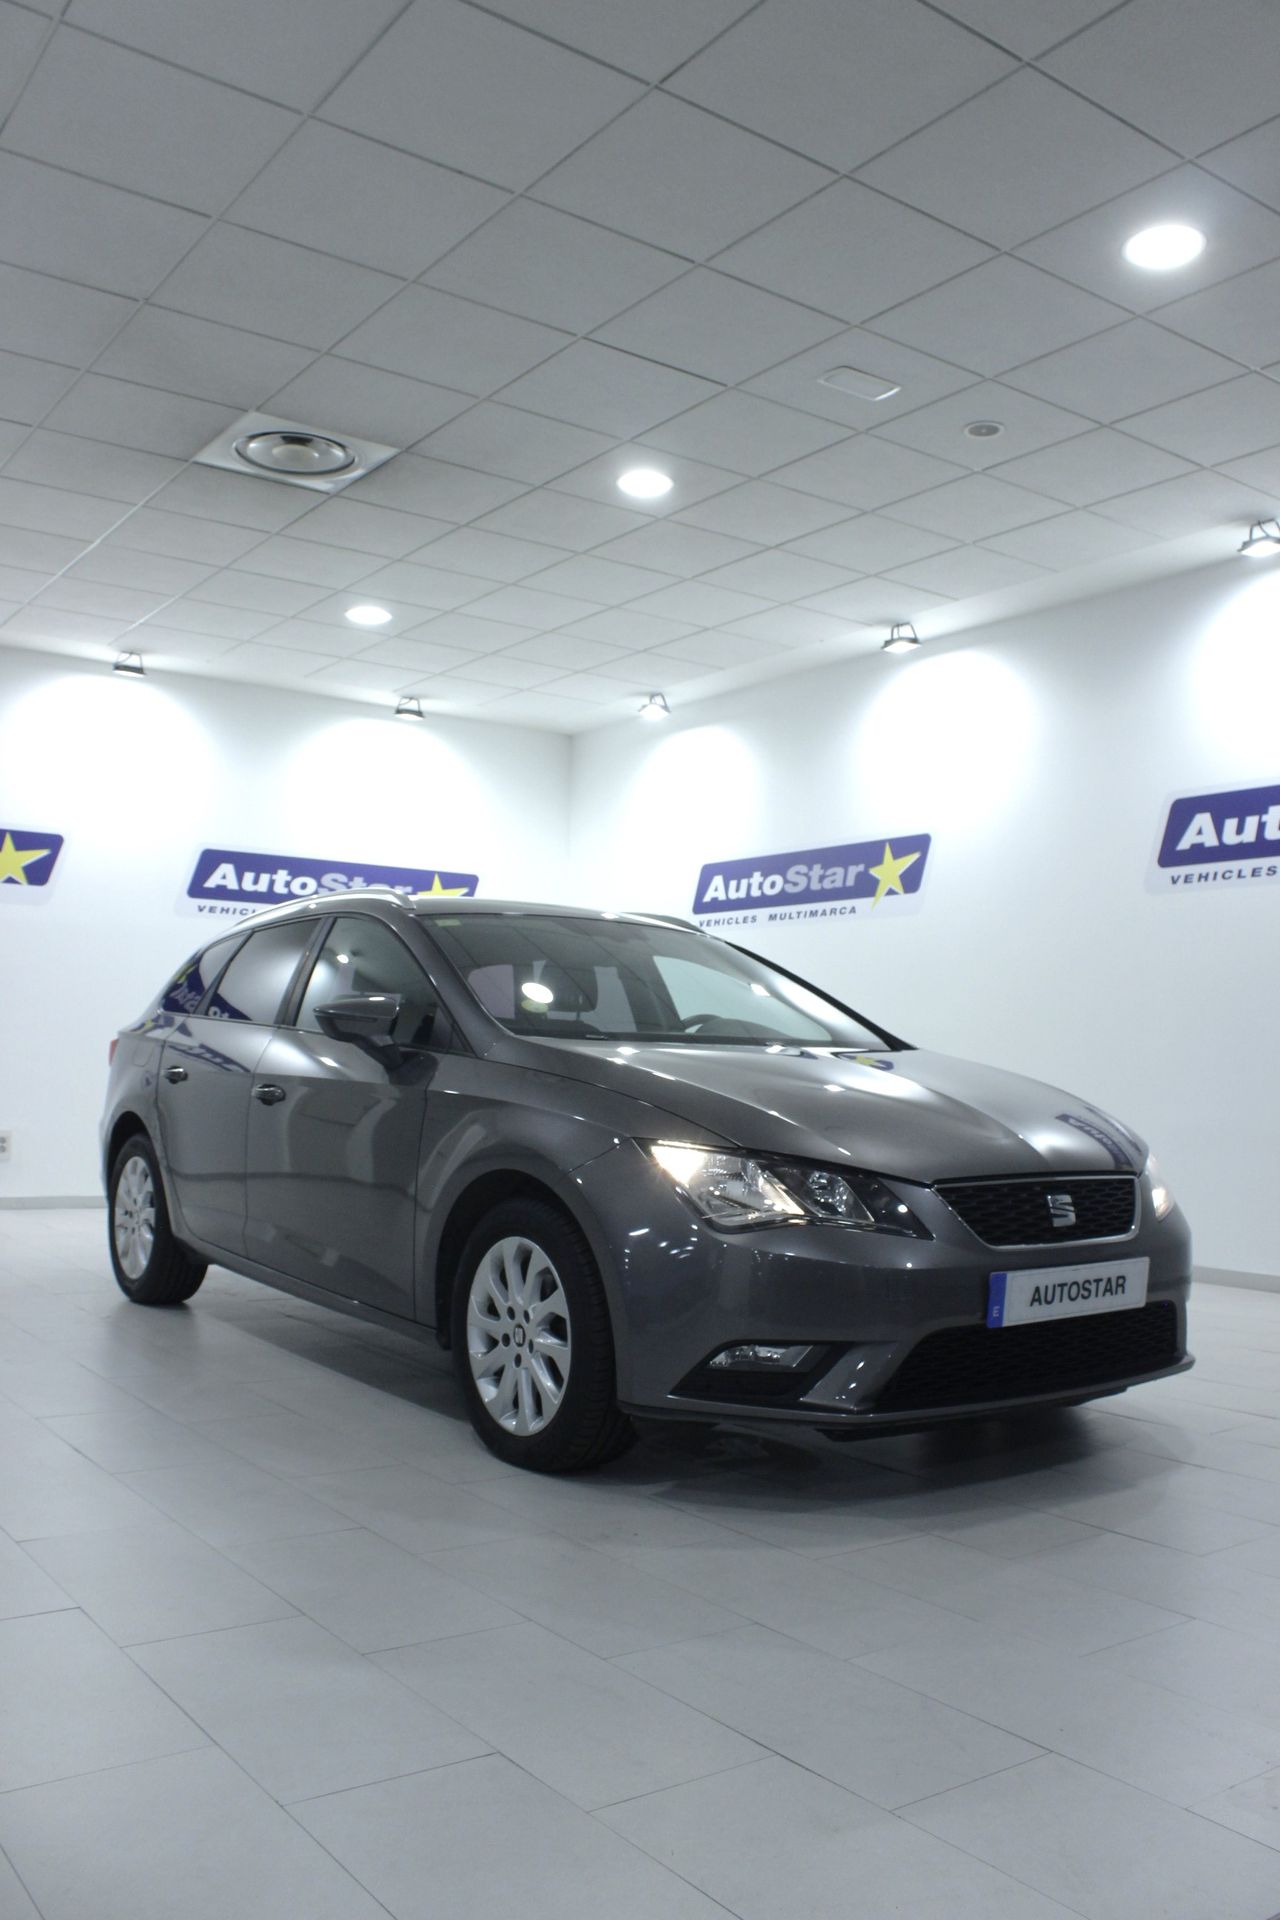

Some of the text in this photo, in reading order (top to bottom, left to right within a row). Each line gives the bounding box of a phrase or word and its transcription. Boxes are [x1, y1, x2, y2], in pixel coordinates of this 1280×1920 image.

[203, 862, 413, 895] AutoSt
[702, 863, 866, 902] AutoStar
[1170, 865, 1278, 885] VEHICLES
[699, 906, 857, 928] VEHICLES MULTIMARCA
[1029, 1275, 1126, 1307] AUTOSTAR
